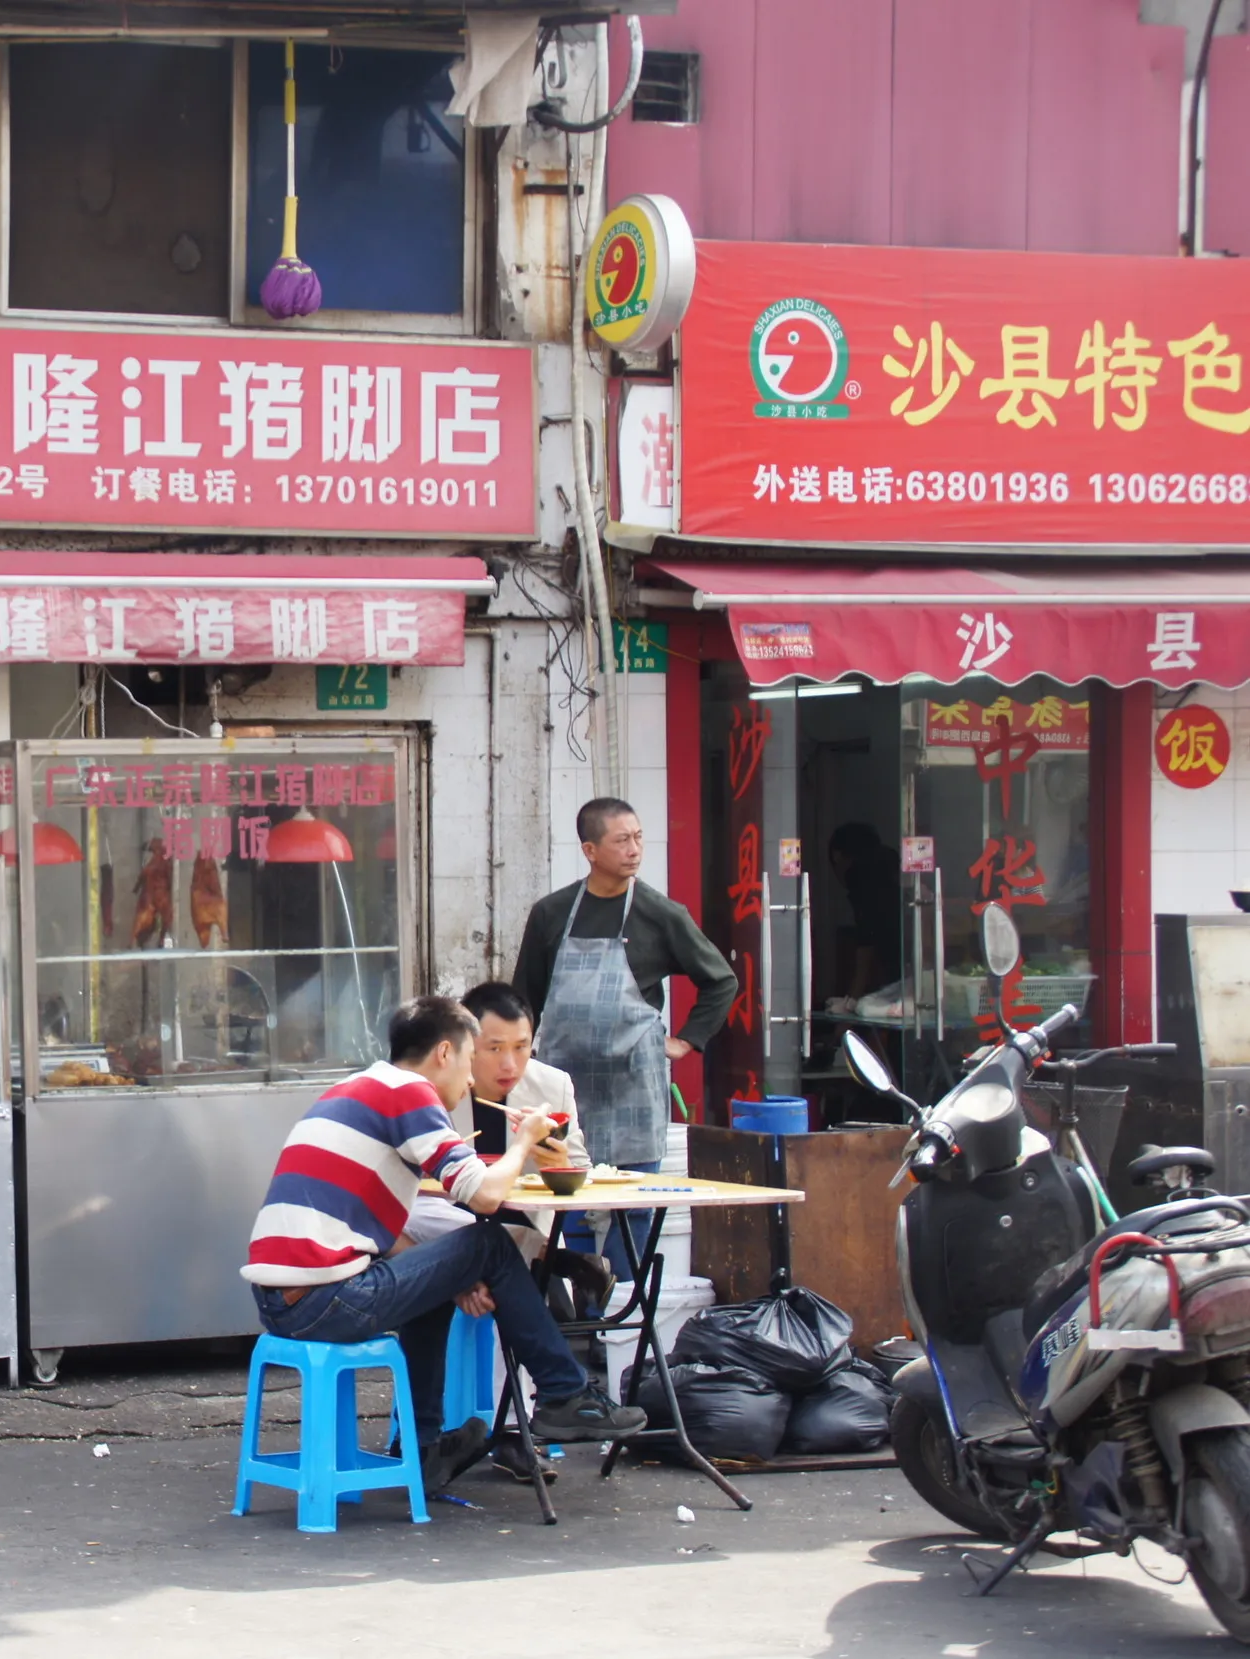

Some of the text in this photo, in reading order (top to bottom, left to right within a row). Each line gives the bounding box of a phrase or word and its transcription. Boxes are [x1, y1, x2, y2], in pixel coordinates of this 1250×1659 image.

[753, 298, 794, 336] SHAXIAN
[881, 319, 1250, 435] 沙县特色
[771, 404, 828, 419] 沙县小吃
[275, 474, 498, 507] 13701619011
[1088, 472, 1250, 504] 13062668
[338, 664, 369, 690] 72
[1160, 717, 1225, 776] 饭
[46, 763, 384, 808] 广东正宗隆江猪脚店
[162, 815, 270, 861] 猪脚饭
